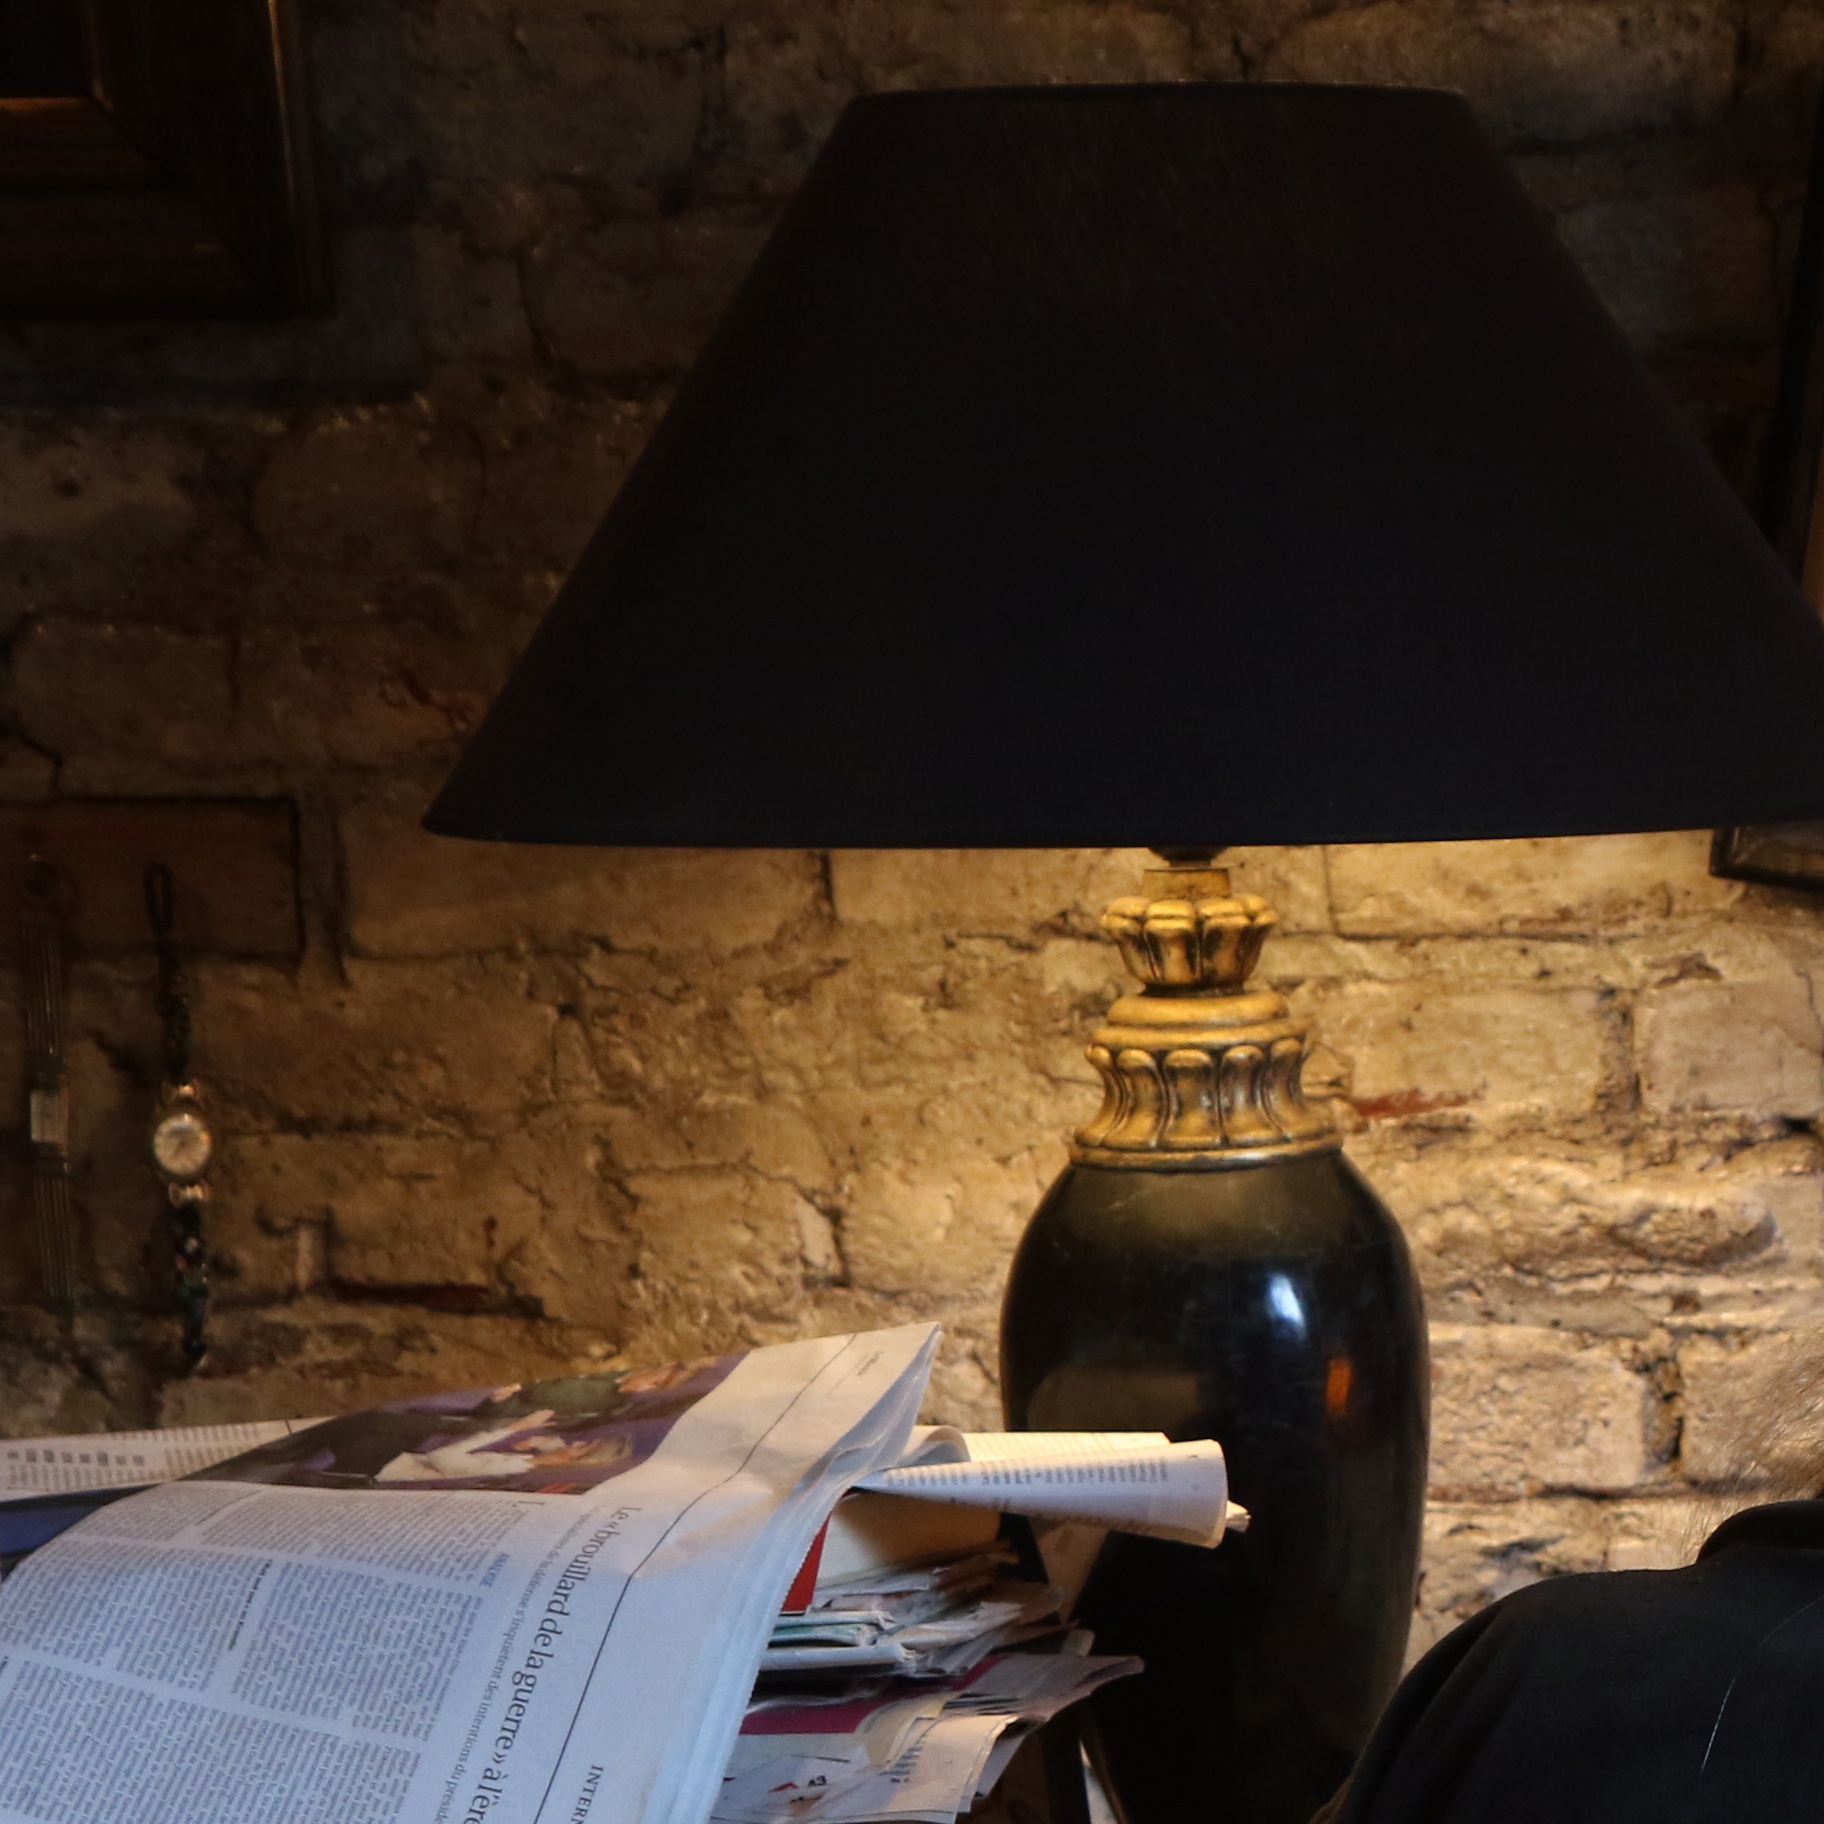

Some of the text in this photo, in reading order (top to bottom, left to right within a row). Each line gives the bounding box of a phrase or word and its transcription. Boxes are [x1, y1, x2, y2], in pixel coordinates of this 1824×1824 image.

[611, 1506, 642, 1520] Le
[534, 1618, 563, 1647] de
[525, 1649, 554, 1669] la
[482, 1680, 500, 1700] des
[459, 1701, 492, 1762] intentions
[450, 1764, 466, 1779] du
[482, 1767, 509, 1782] à
